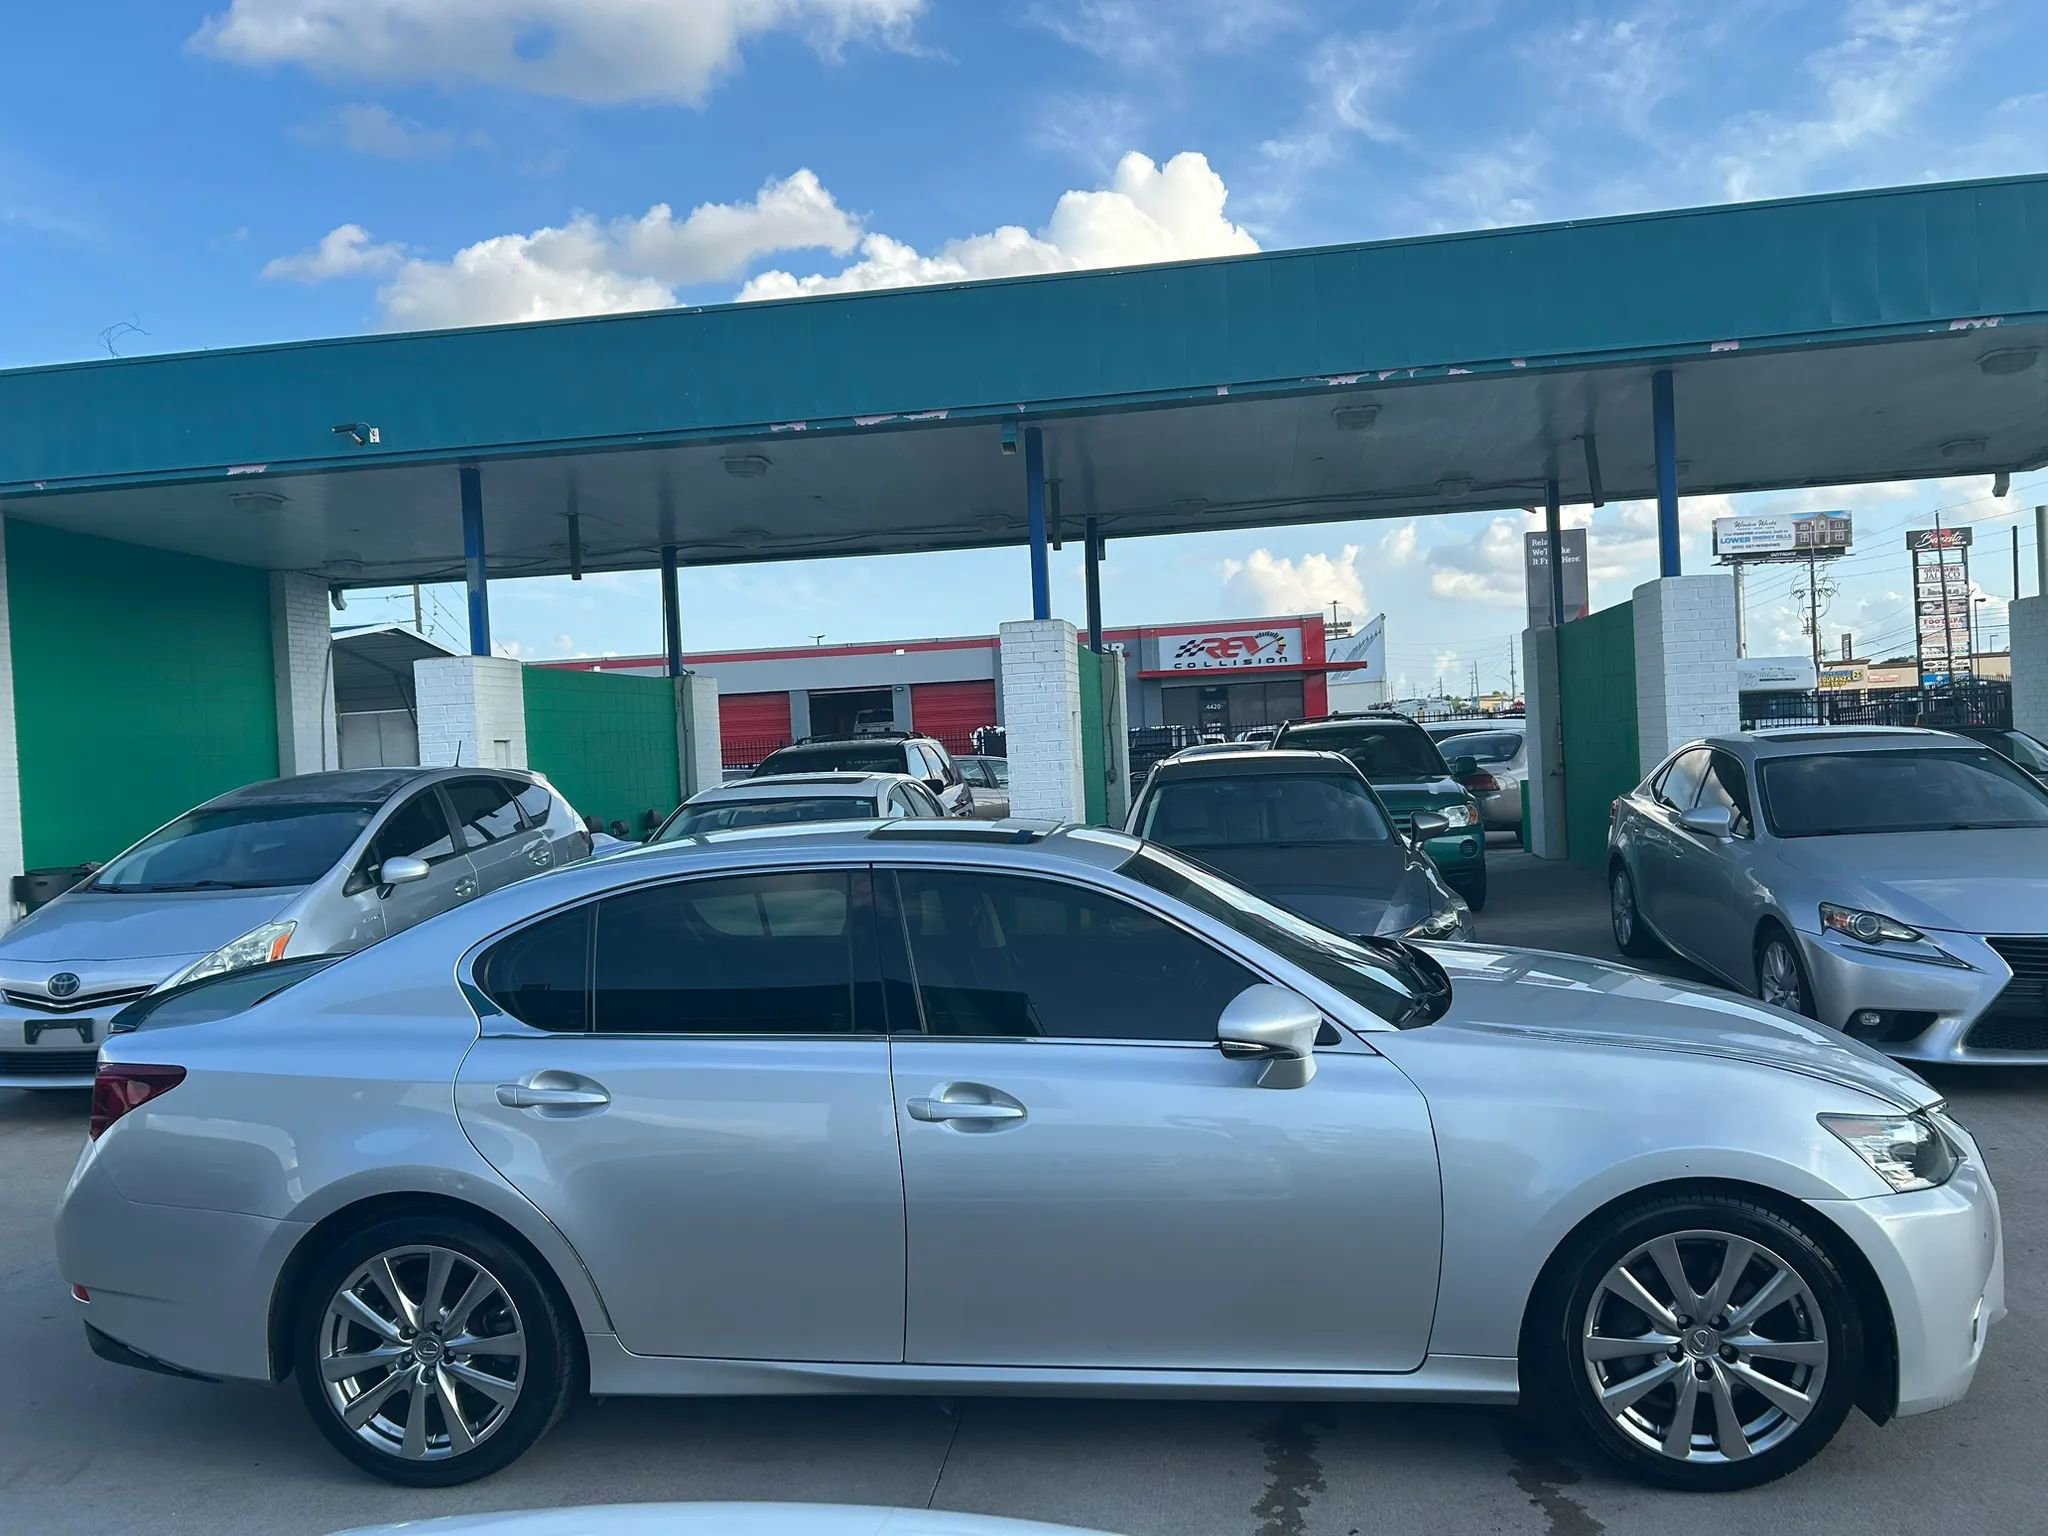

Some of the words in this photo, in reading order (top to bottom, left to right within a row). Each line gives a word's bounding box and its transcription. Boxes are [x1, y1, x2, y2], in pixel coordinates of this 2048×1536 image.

[1531, 538, 1548, 547] Rela
[1720, 536, 1751, 544] LOWER
[1925, 570, 1961, 581] JALSCO
[1197, 635, 1259, 659] REV
[1174, 656, 1288, 669] COLLISION
